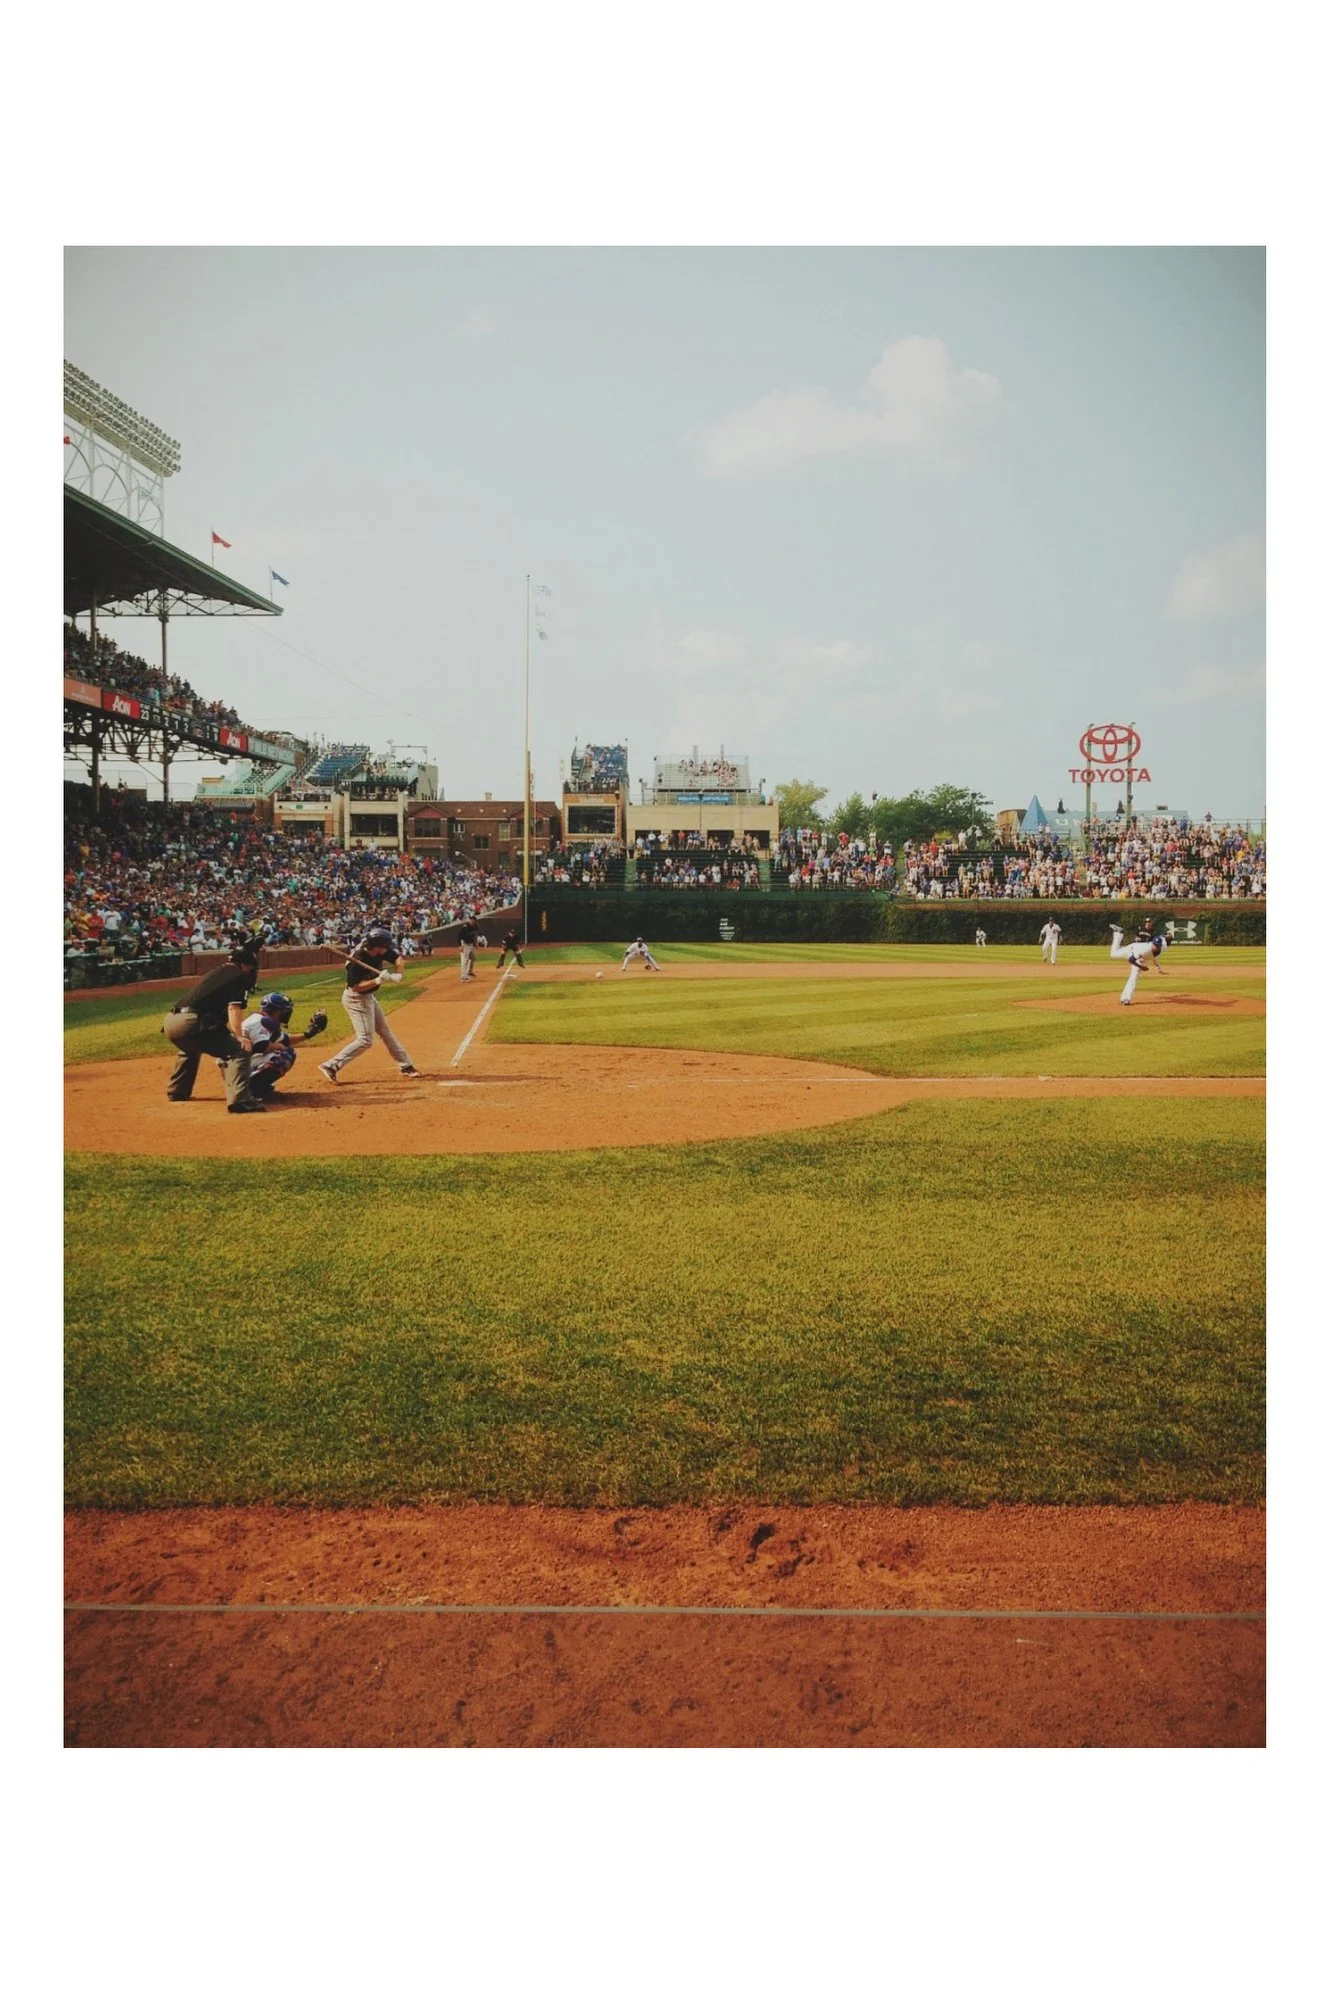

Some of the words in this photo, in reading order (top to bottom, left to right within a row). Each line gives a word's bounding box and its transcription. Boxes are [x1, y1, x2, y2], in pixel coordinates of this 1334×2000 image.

[112, 695, 131, 716] AON
[227, 732, 241, 749] AON
[1068, 768, 1152, 783] TOYOTA
